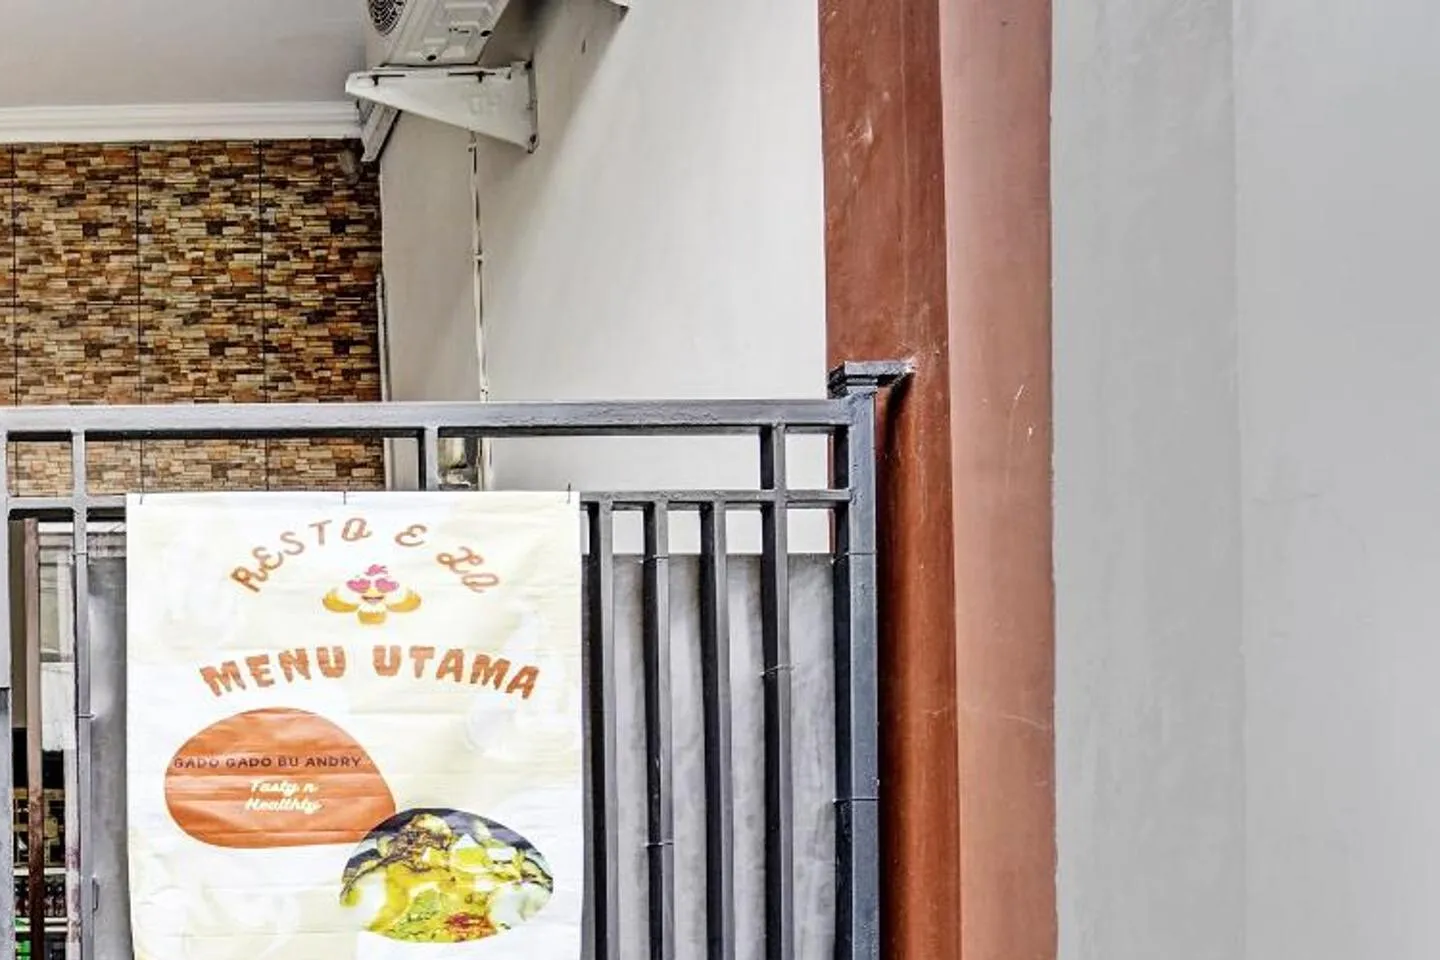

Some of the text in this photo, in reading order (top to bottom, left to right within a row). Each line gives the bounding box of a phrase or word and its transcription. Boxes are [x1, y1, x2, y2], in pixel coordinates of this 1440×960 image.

[199, 645, 540, 700] MENU UTAMA
[174, 756, 361, 769] GADO GADO BU ANDRY
[249, 780, 299, 797] Tasty
[244, 798, 324, 815] Healthy
